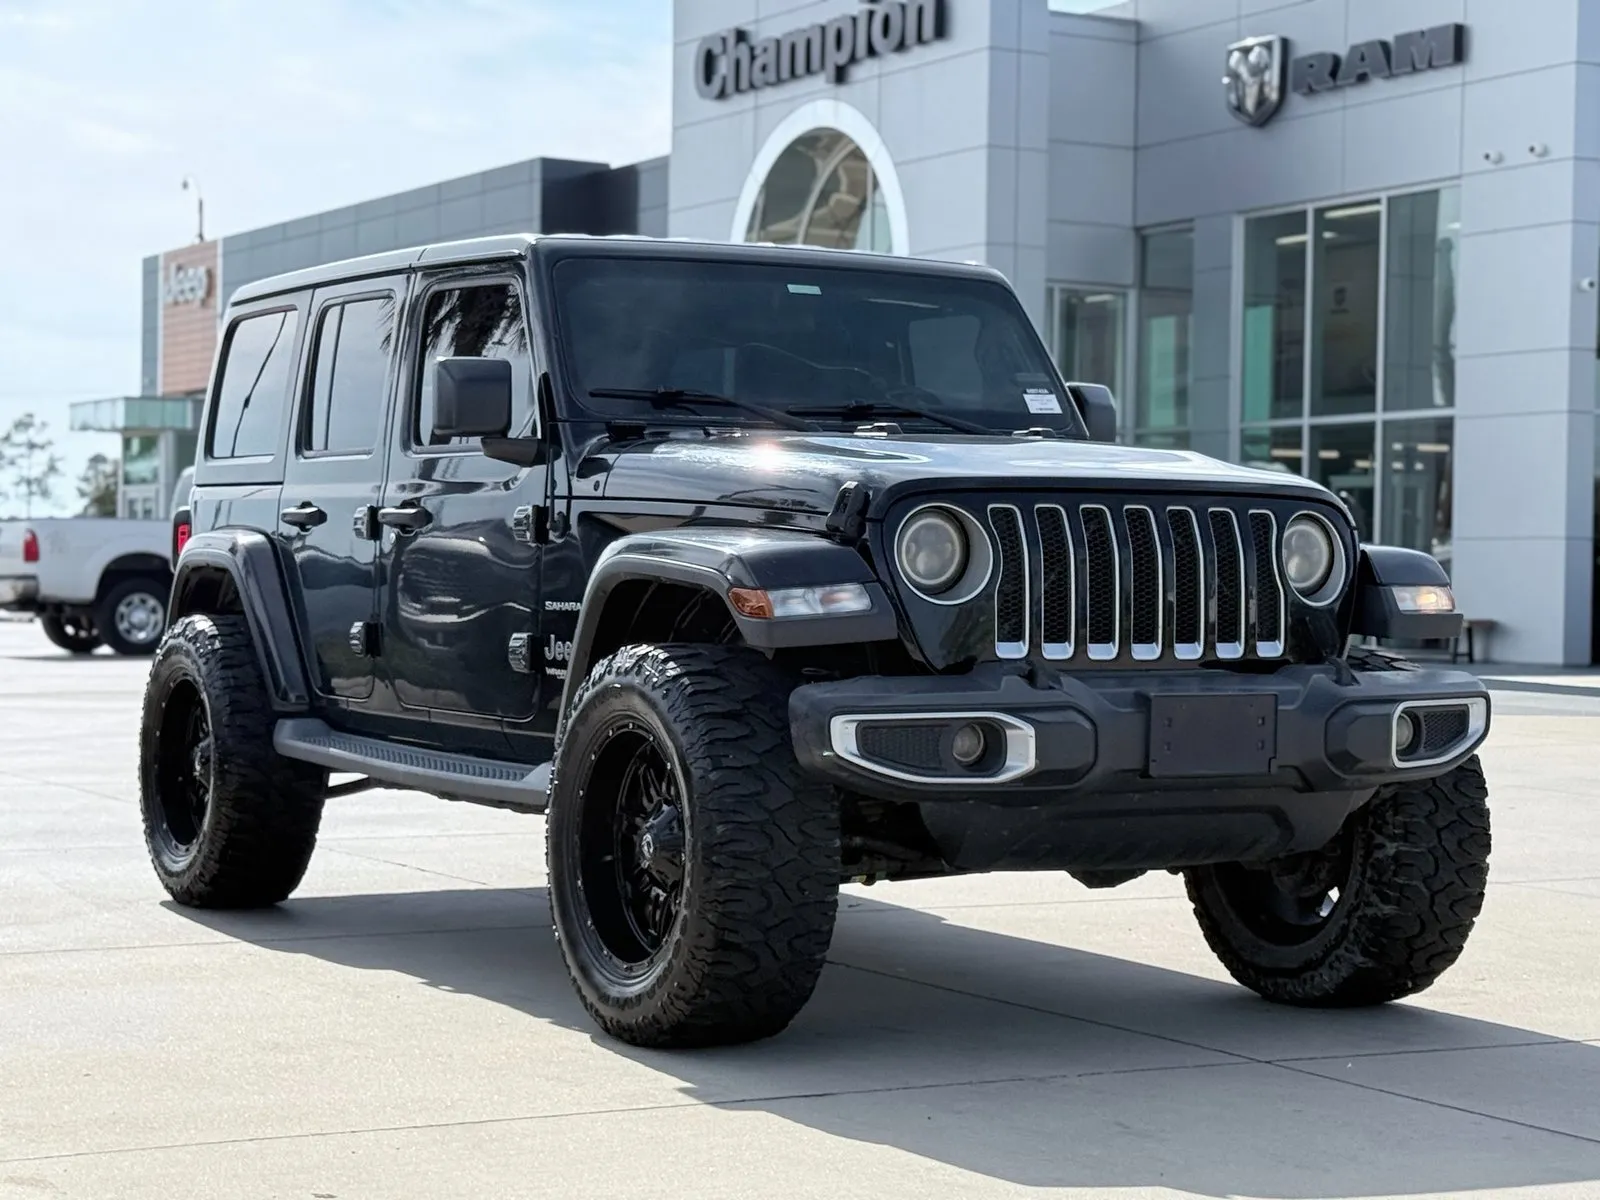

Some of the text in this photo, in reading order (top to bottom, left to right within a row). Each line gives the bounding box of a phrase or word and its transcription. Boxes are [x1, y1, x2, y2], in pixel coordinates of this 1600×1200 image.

[694, 0, 949, 100] Champion
[1291, 23, 1468, 95] RAM
[544, 600, 581, 611] SAHARA
[544, 633, 573, 661] Jee
